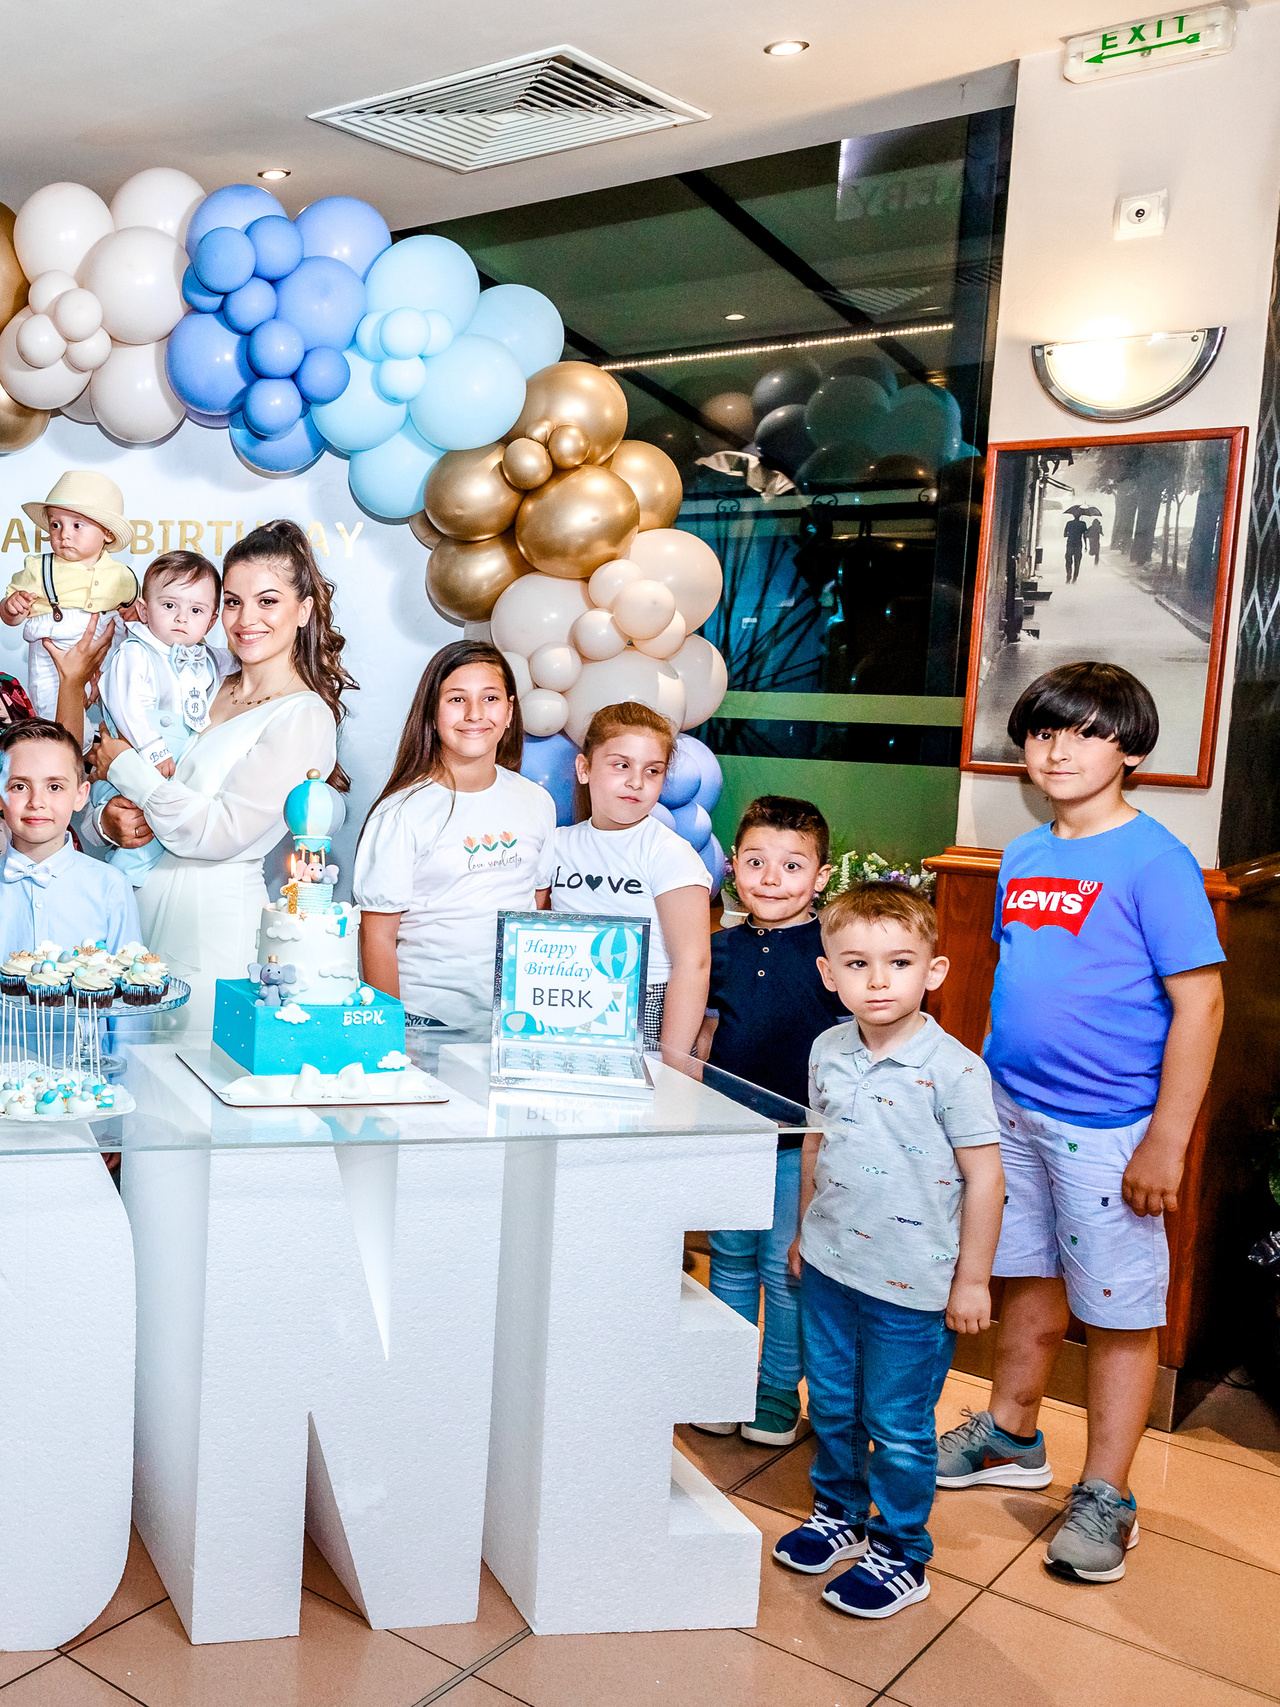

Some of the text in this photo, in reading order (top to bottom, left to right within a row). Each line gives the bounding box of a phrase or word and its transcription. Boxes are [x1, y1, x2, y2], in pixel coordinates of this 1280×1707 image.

[1101, 15, 1190, 51] EXIT
[127, 519, 364, 558] BIRTAY
[337, 916, 348, 938] 1
[524, 938, 577, 959] Happy
[524, 961, 593, 982] Birthday
[532, 987, 593, 1009] BERK
